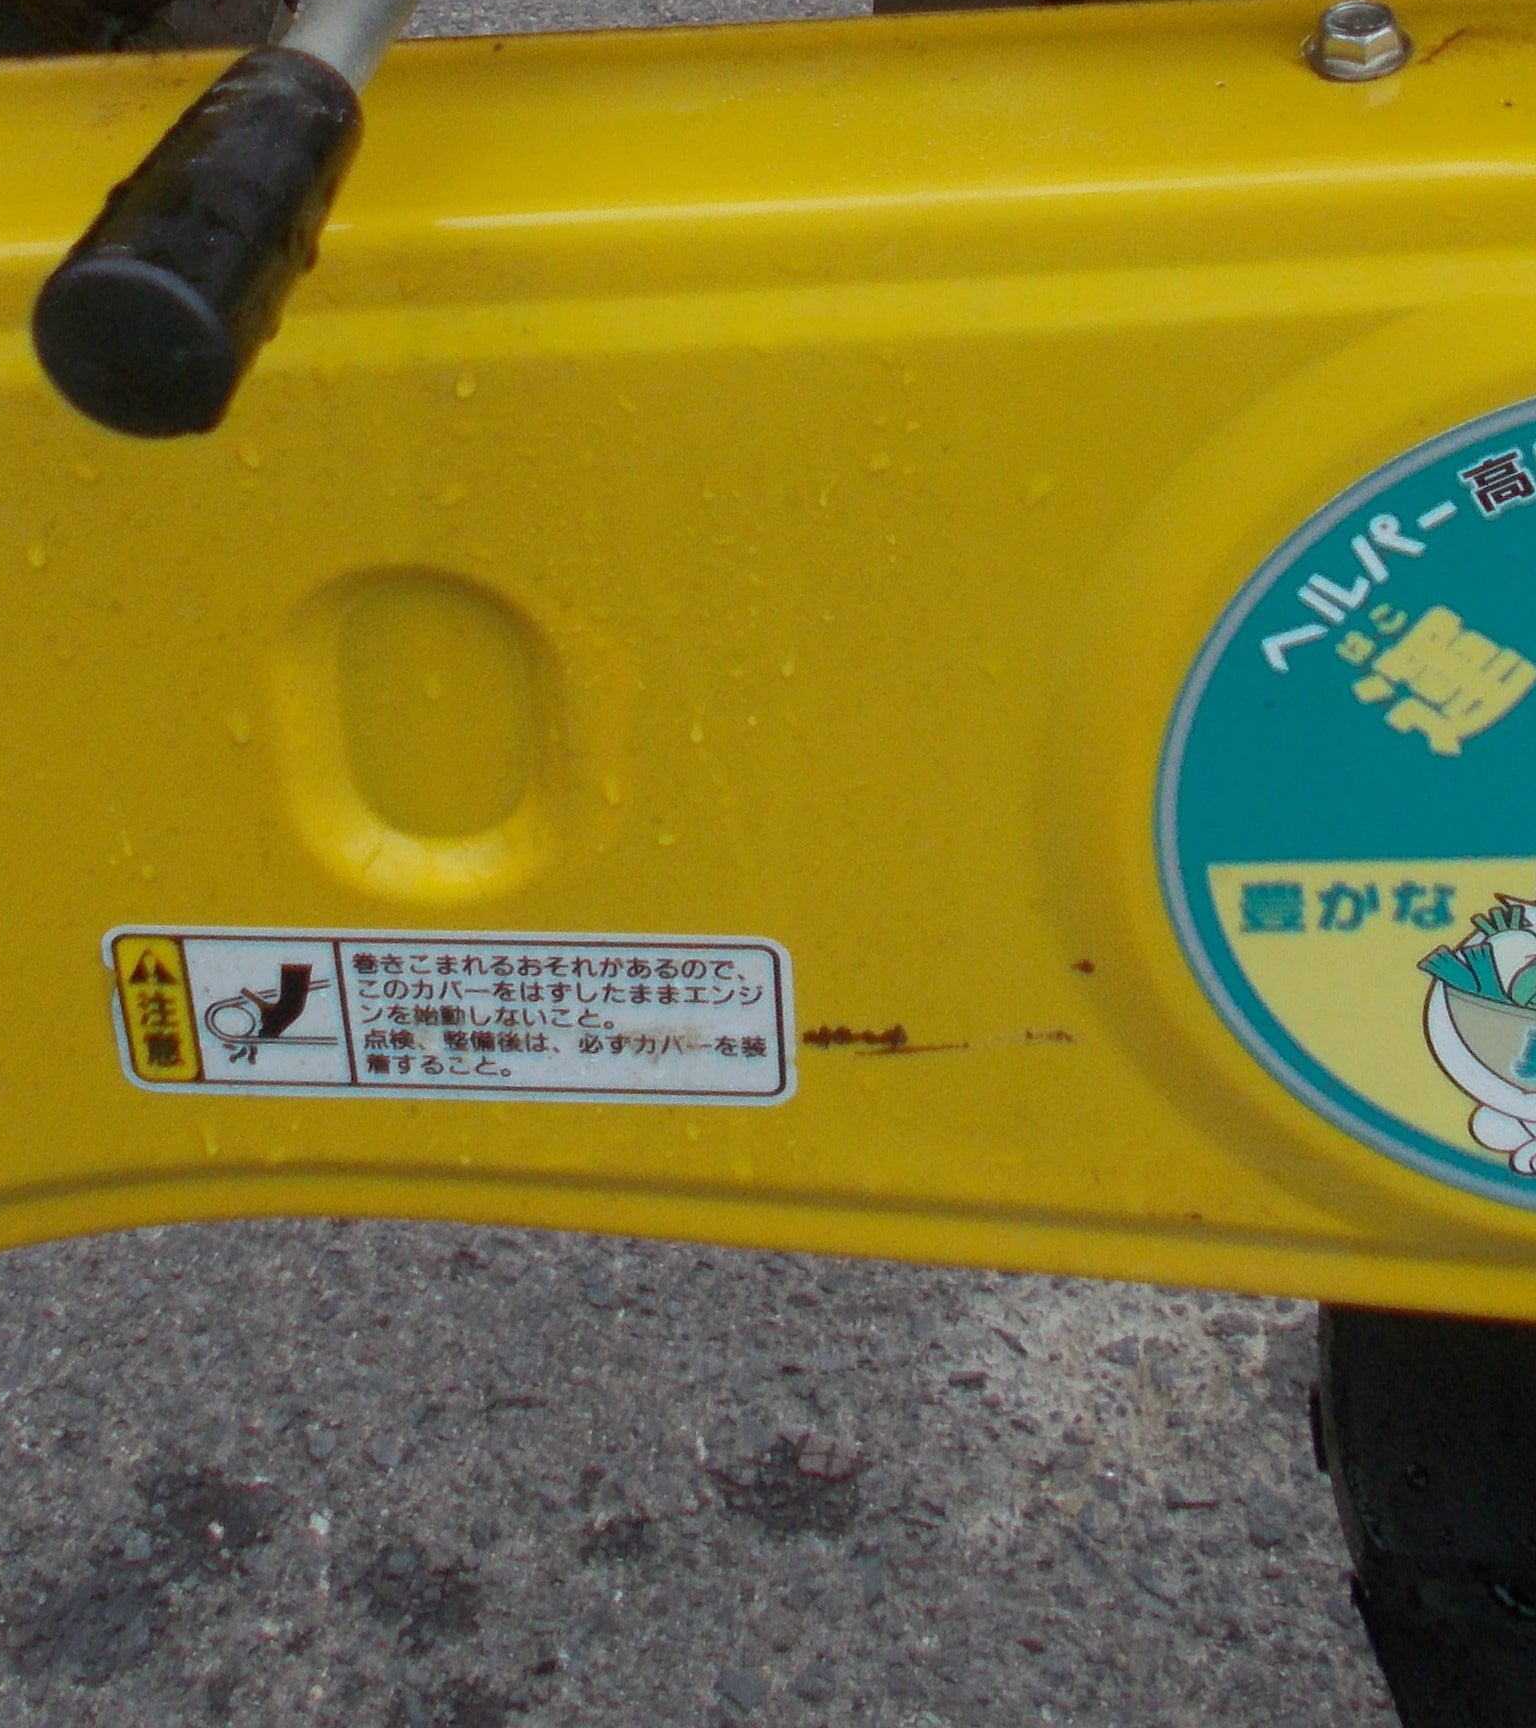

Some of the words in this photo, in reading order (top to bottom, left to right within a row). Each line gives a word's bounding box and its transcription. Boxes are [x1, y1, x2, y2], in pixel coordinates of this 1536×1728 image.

[1262, 500, 1457, 673] ヘルパー
[1238, 876, 1457, 936] 豊かな
[357, 978, 764, 1005] このカバーをはずしたままエンジ
[360, 1004, 615, 1030] ンを始動しないこと。
